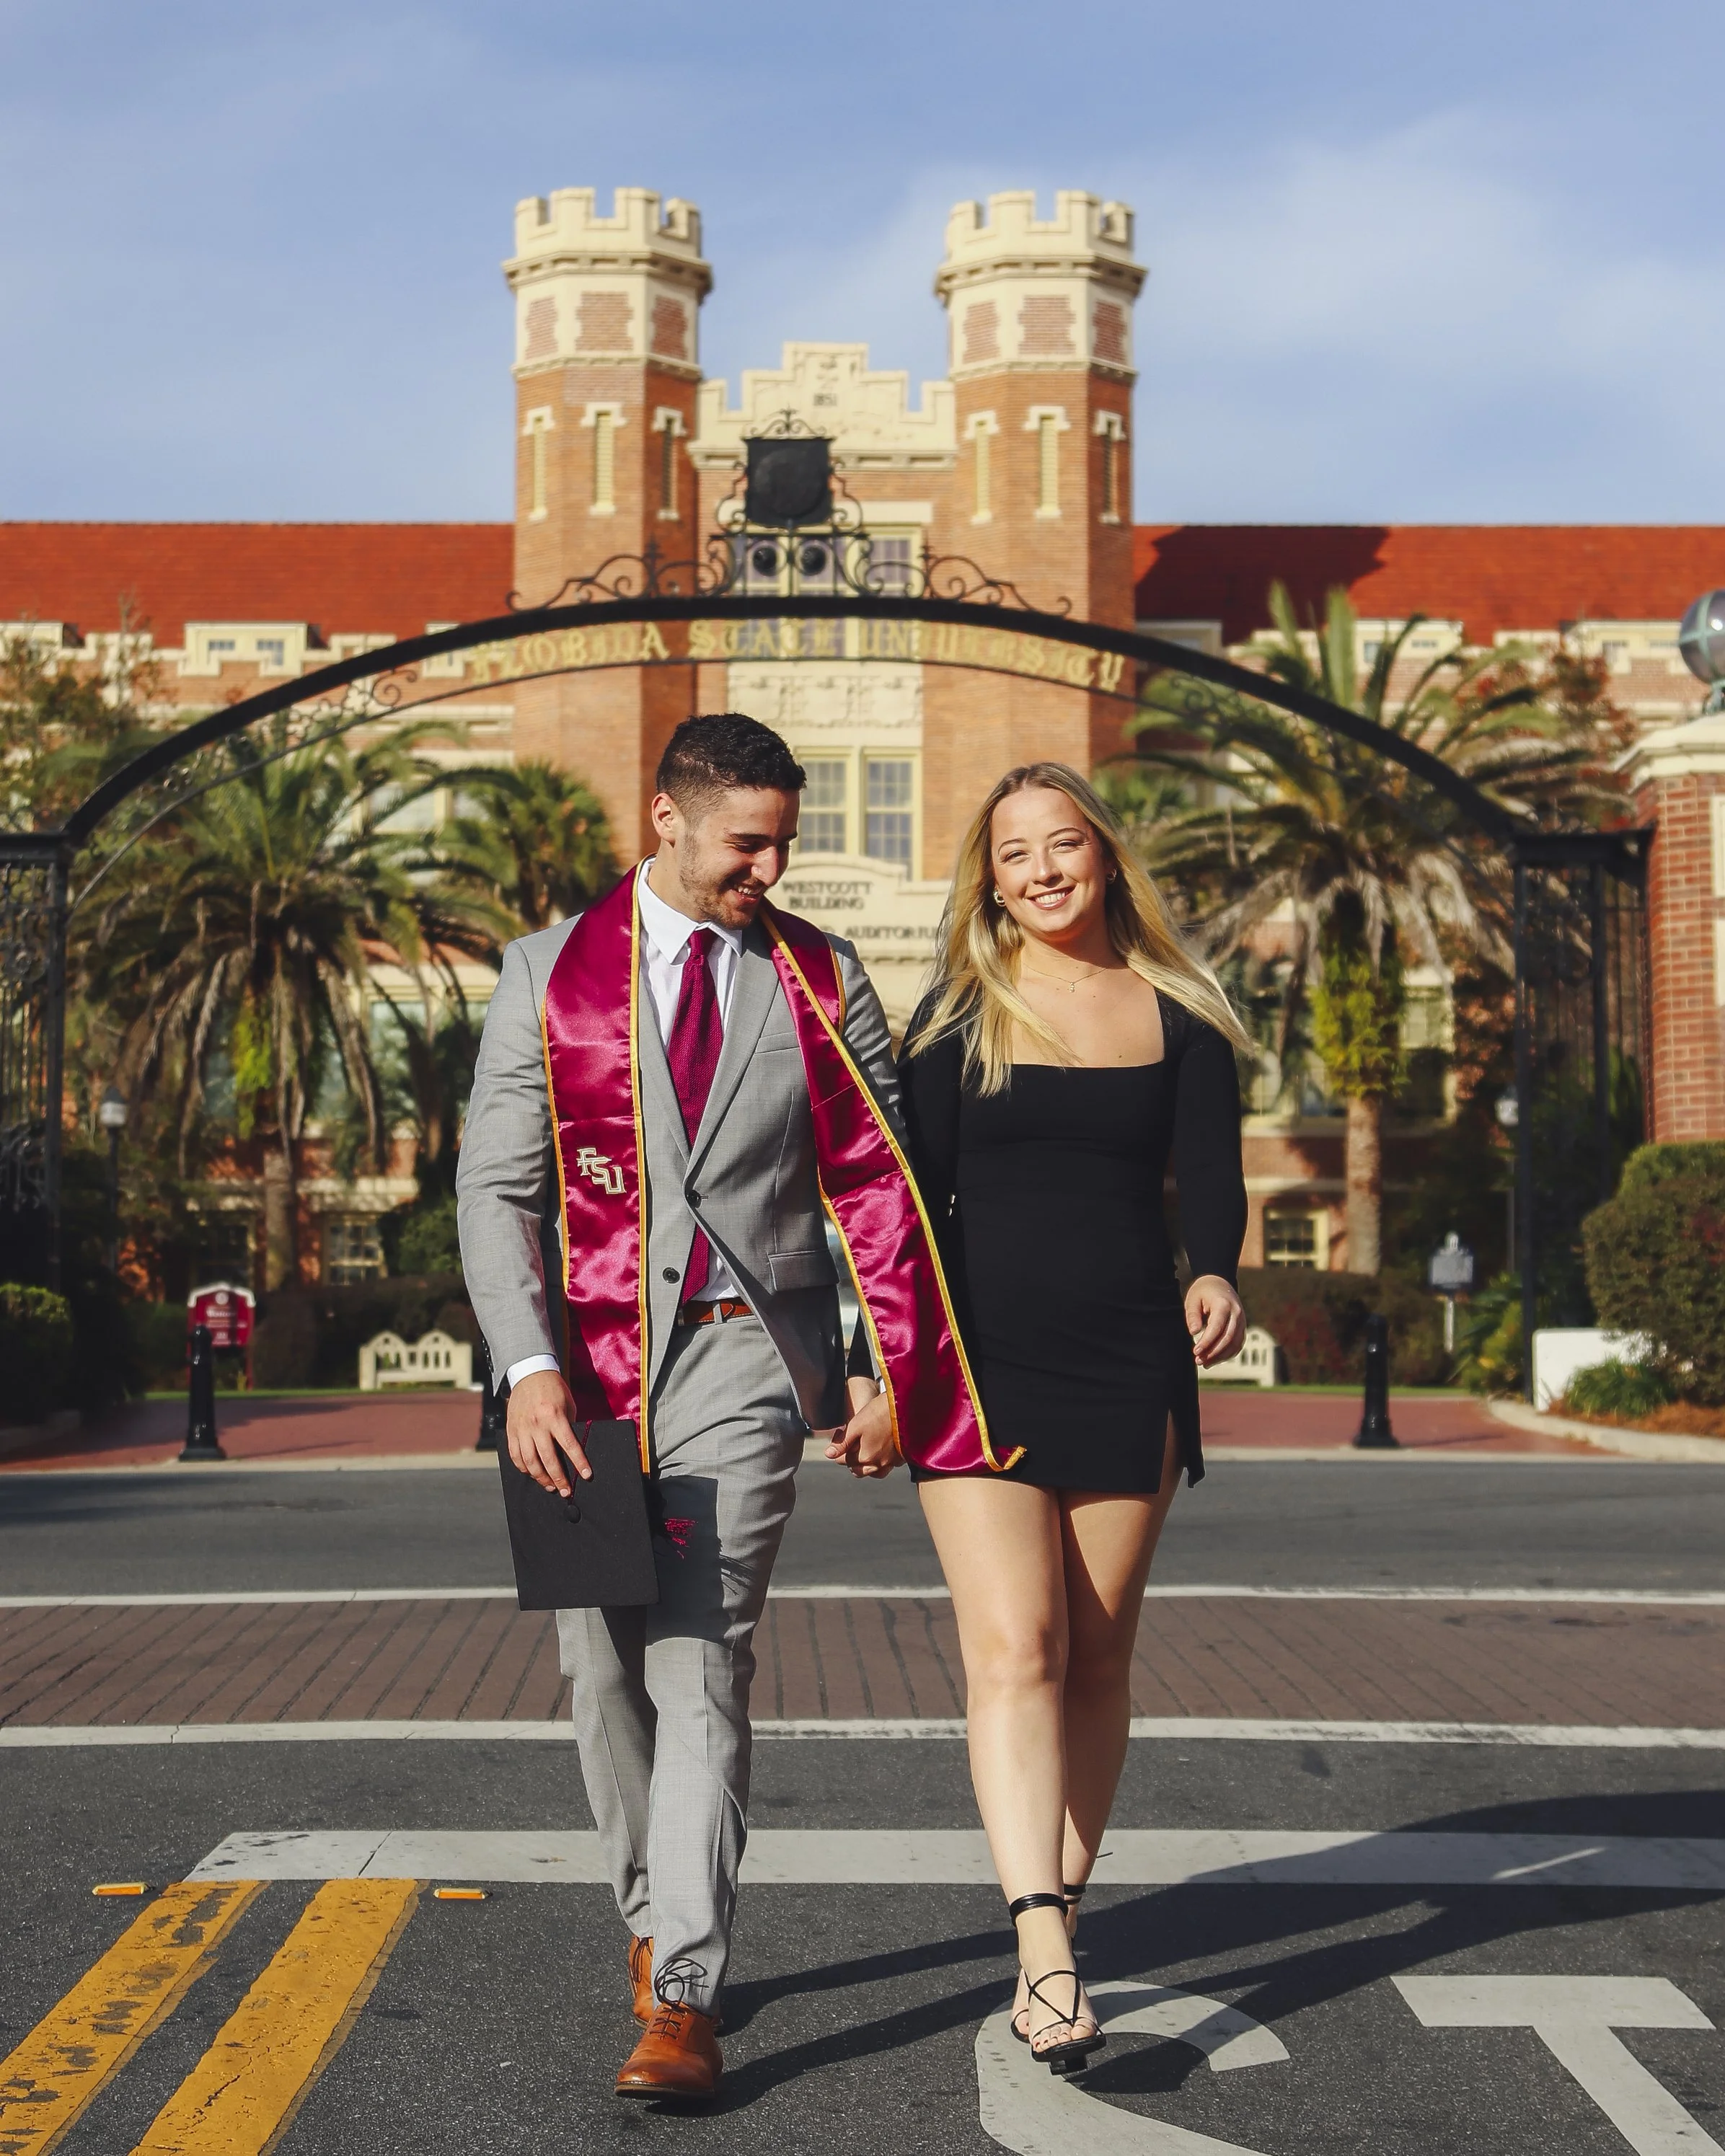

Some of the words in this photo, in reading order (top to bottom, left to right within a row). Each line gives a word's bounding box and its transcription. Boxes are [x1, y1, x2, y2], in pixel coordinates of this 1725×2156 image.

[472, 621, 670, 684] FLORIDA
[688, 618, 837, 658] STATE
[860, 619, 1125, 692] UNIVERSITY
[782, 880, 873, 894] WESTCOTT
[790, 896, 864, 909] BUILDING
[844, 925, 939, 938] AUDITORIU
[576, 1147, 627, 1195] FSU
